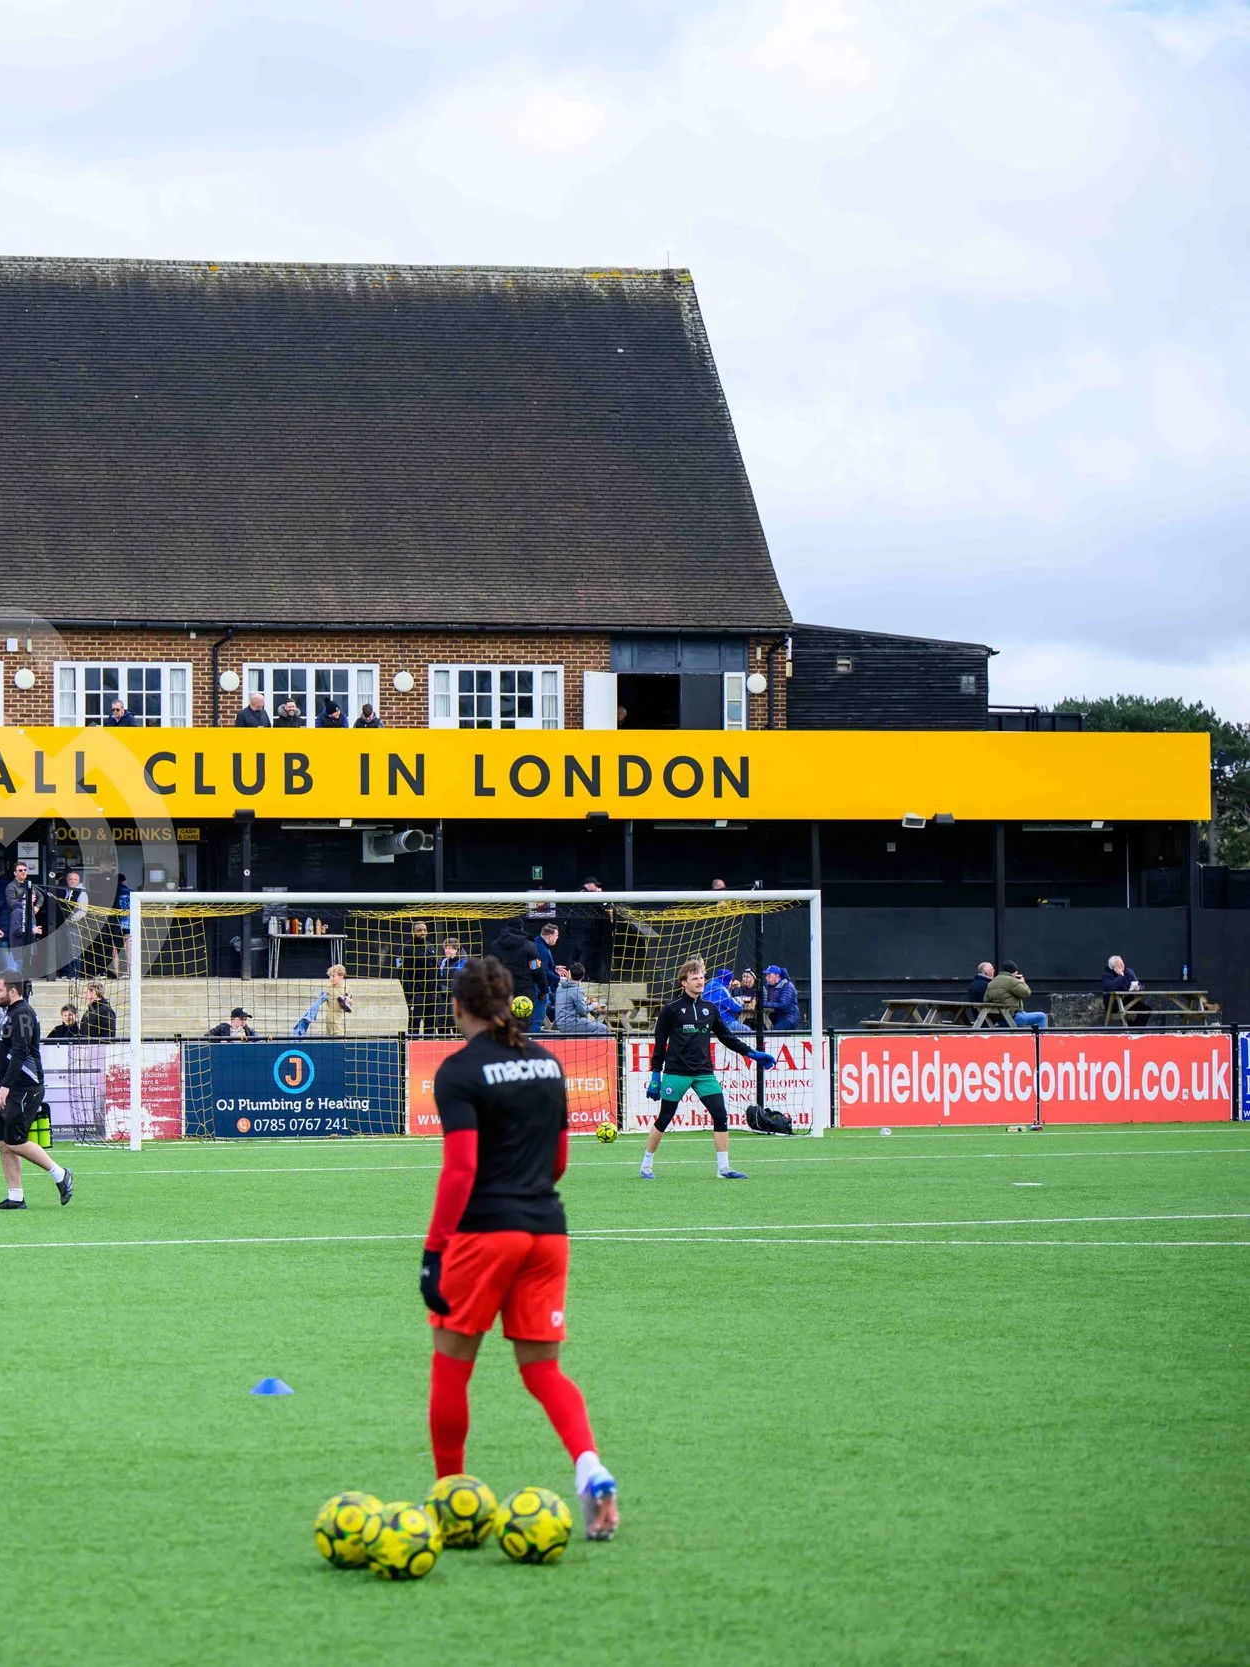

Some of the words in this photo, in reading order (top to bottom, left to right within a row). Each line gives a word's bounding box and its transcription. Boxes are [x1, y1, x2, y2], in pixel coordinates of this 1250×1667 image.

[143, 751, 314, 796] CLUB
[360, 752, 425, 796] IN
[474, 753, 750, 799] LONDON
[54, 827, 91, 840] OOD
[96, 827, 107, 840] &
[112, 827, 172, 840] DRINKS
[482, 1058, 562, 1085] macron
[742, 1079, 814, 1088] DEELOPING
[840, 1049, 1230, 1117] shieldpestcontrol.co.uk
[765, 1093, 786, 1102] 1938
[216, 1100, 234, 1111] OJ
[238, 1098, 302, 1113] Plumbing
[306, 1098, 314, 1110] &
[318, 1098, 370, 1112] Heating
[254, 1119, 286, 1131] 0785
[290, 1118, 321, 1131] 0767
[324, 1118, 348, 1130] 241
